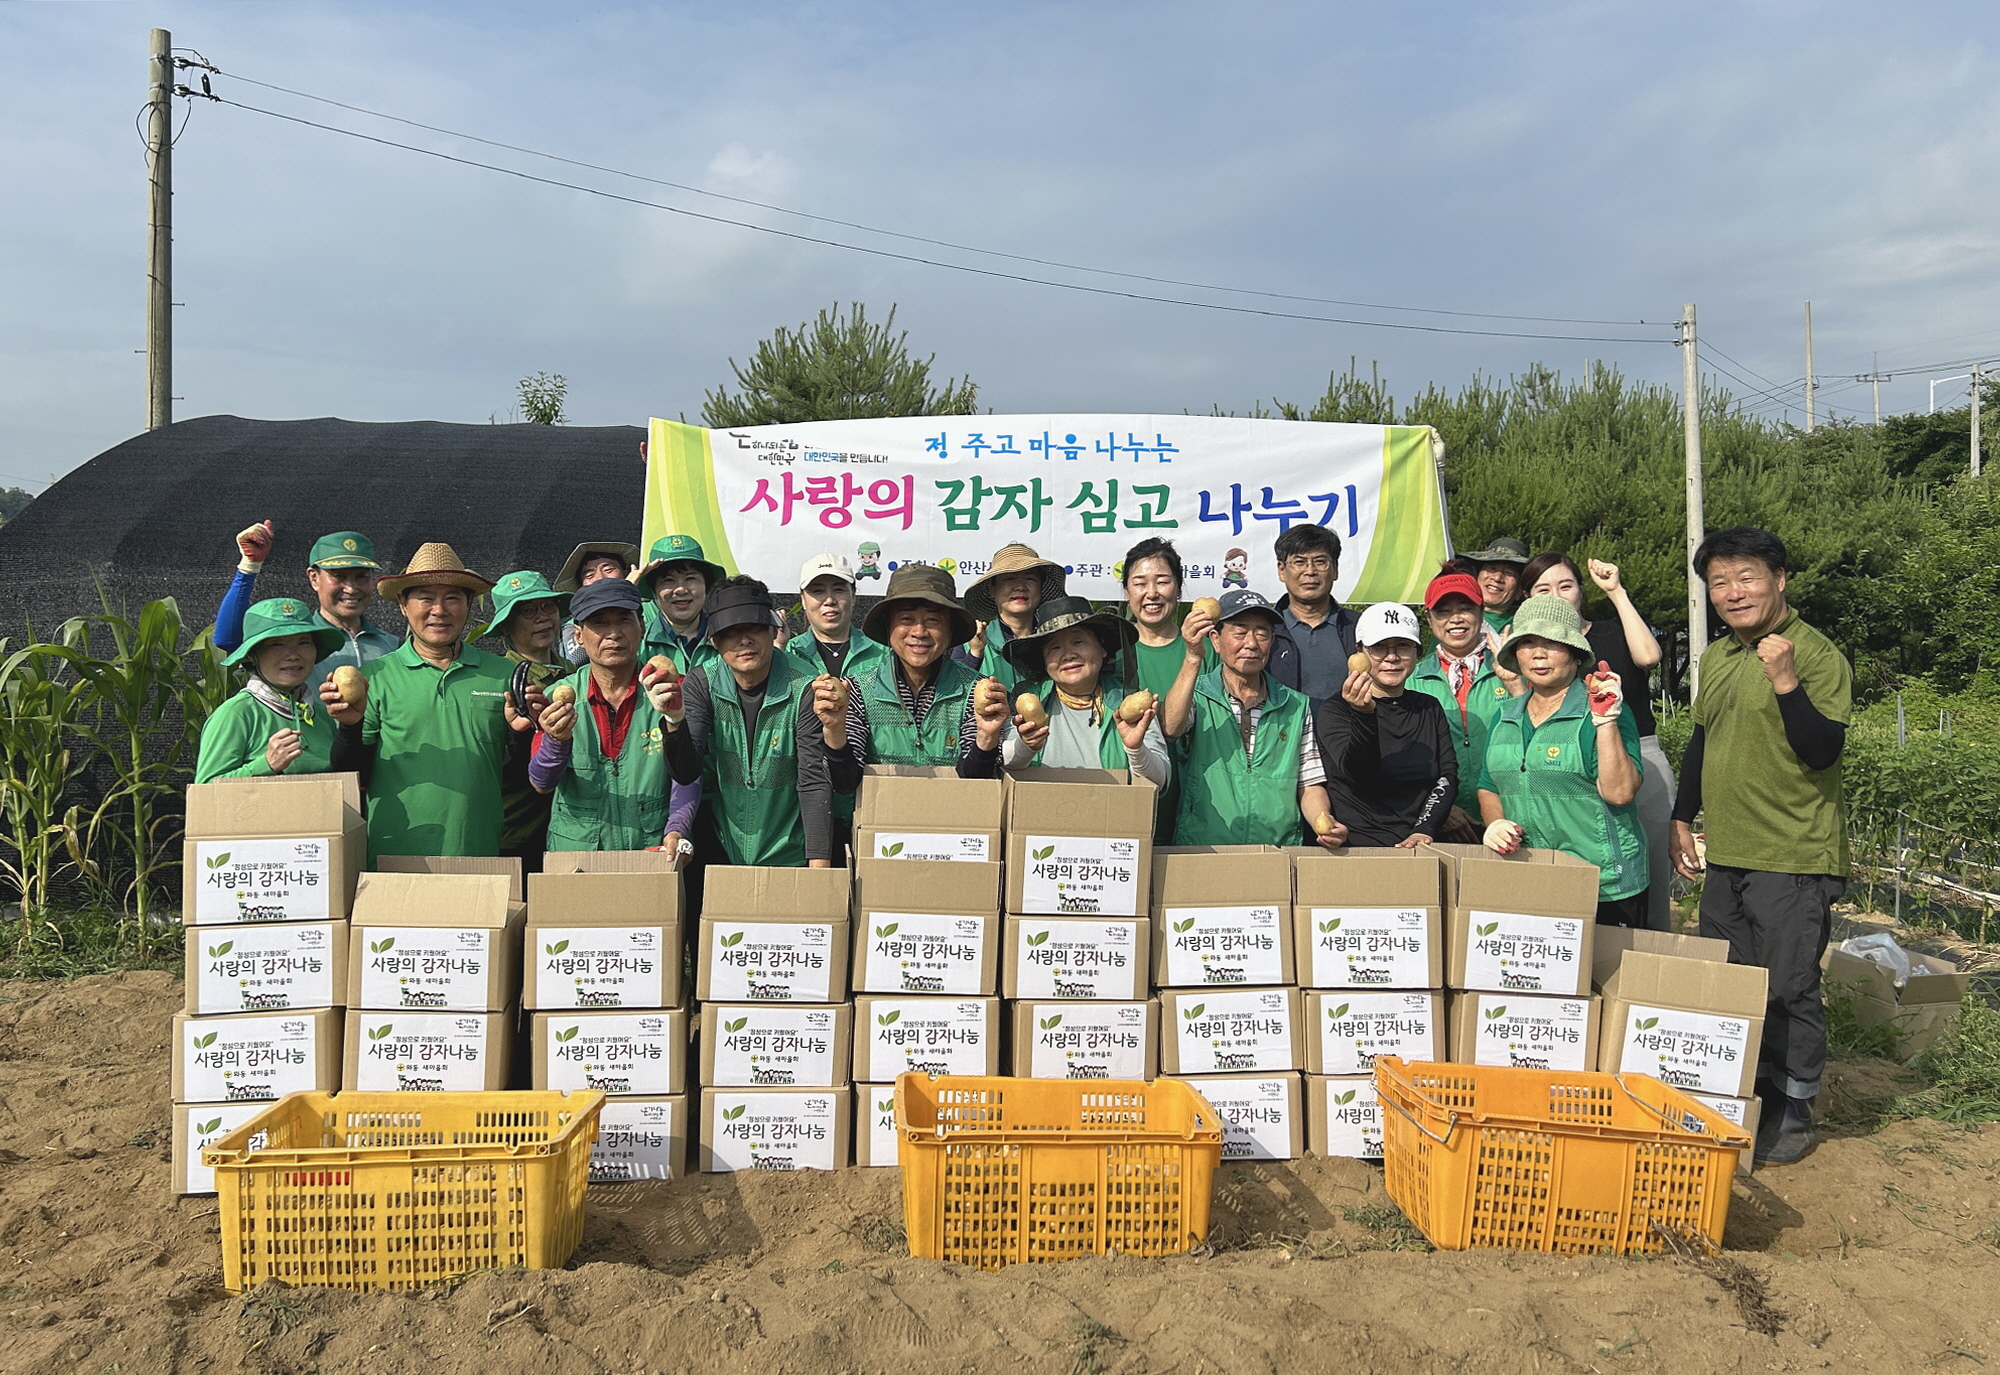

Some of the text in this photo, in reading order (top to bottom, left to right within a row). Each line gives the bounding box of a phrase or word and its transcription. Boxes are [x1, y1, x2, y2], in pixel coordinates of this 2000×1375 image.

[925, 431, 1180, 463] 정 주고 마음 나누는
[804, 452, 848, 463] 대한민국을
[740, 471, 1359, 538] 사랑의 감자 심고 나누기
[1075, 563, 1103, 578] 주관
[1384, 609, 1400, 624] NY
[207, 870, 319, 888] 사랑의 감자나눔
[1032, 864, 1131, 882] 사랑의 감자나눔
[875, 941, 976, 960] 사랑의 감자나눔
[1175, 934, 1273, 952] 사랑의 감자나눔
[1320, 936, 1420, 952] 사랑의 감자나눔
[1475, 939, 1573, 961] 사랑의 감자나눔
[209, 956, 323, 977] 사랑의 감자나눔
[371, 957, 480, 974] 사랑의 감자나눔
[546, 958, 653, 974] 사랑의 감자나눔
[720, 950, 823, 968] 사랑의 감자나눔
[1027, 949, 1126, 967] 사랑의 감자나눔
[878, 1028, 979, 1045] 사랑의 감자나눔
[1186, 1019, 1283, 1038] 사랑의 감자나눔
[1329, 1019, 1426, 1037] 사랑의 감자나눔
[1484, 1023, 1580, 1043] 사랑의 감자나눔
[724, 1036, 827, 1053] 사랑의 감자나눔
[1040, 1032, 1139, 1048] 사랑의 감자나눔
[1633, 1033, 1737, 1061] 사랑의 감자나눔
[194, 1048, 306, 1068] 사랑의 감자나눔
[368, 1044, 478, 1061] 사랑의 감자나눔
[556, 1043, 662, 1061] 사랑의 감자나눔
[1228, 1107, 1281, 1124] 감자나눔
[1335, 1108, 1375, 1124] 사랑의
[605, 1131, 662, 1148] 감자나눔
[723, 1123, 826, 1139] 사랑의 감자나눔
